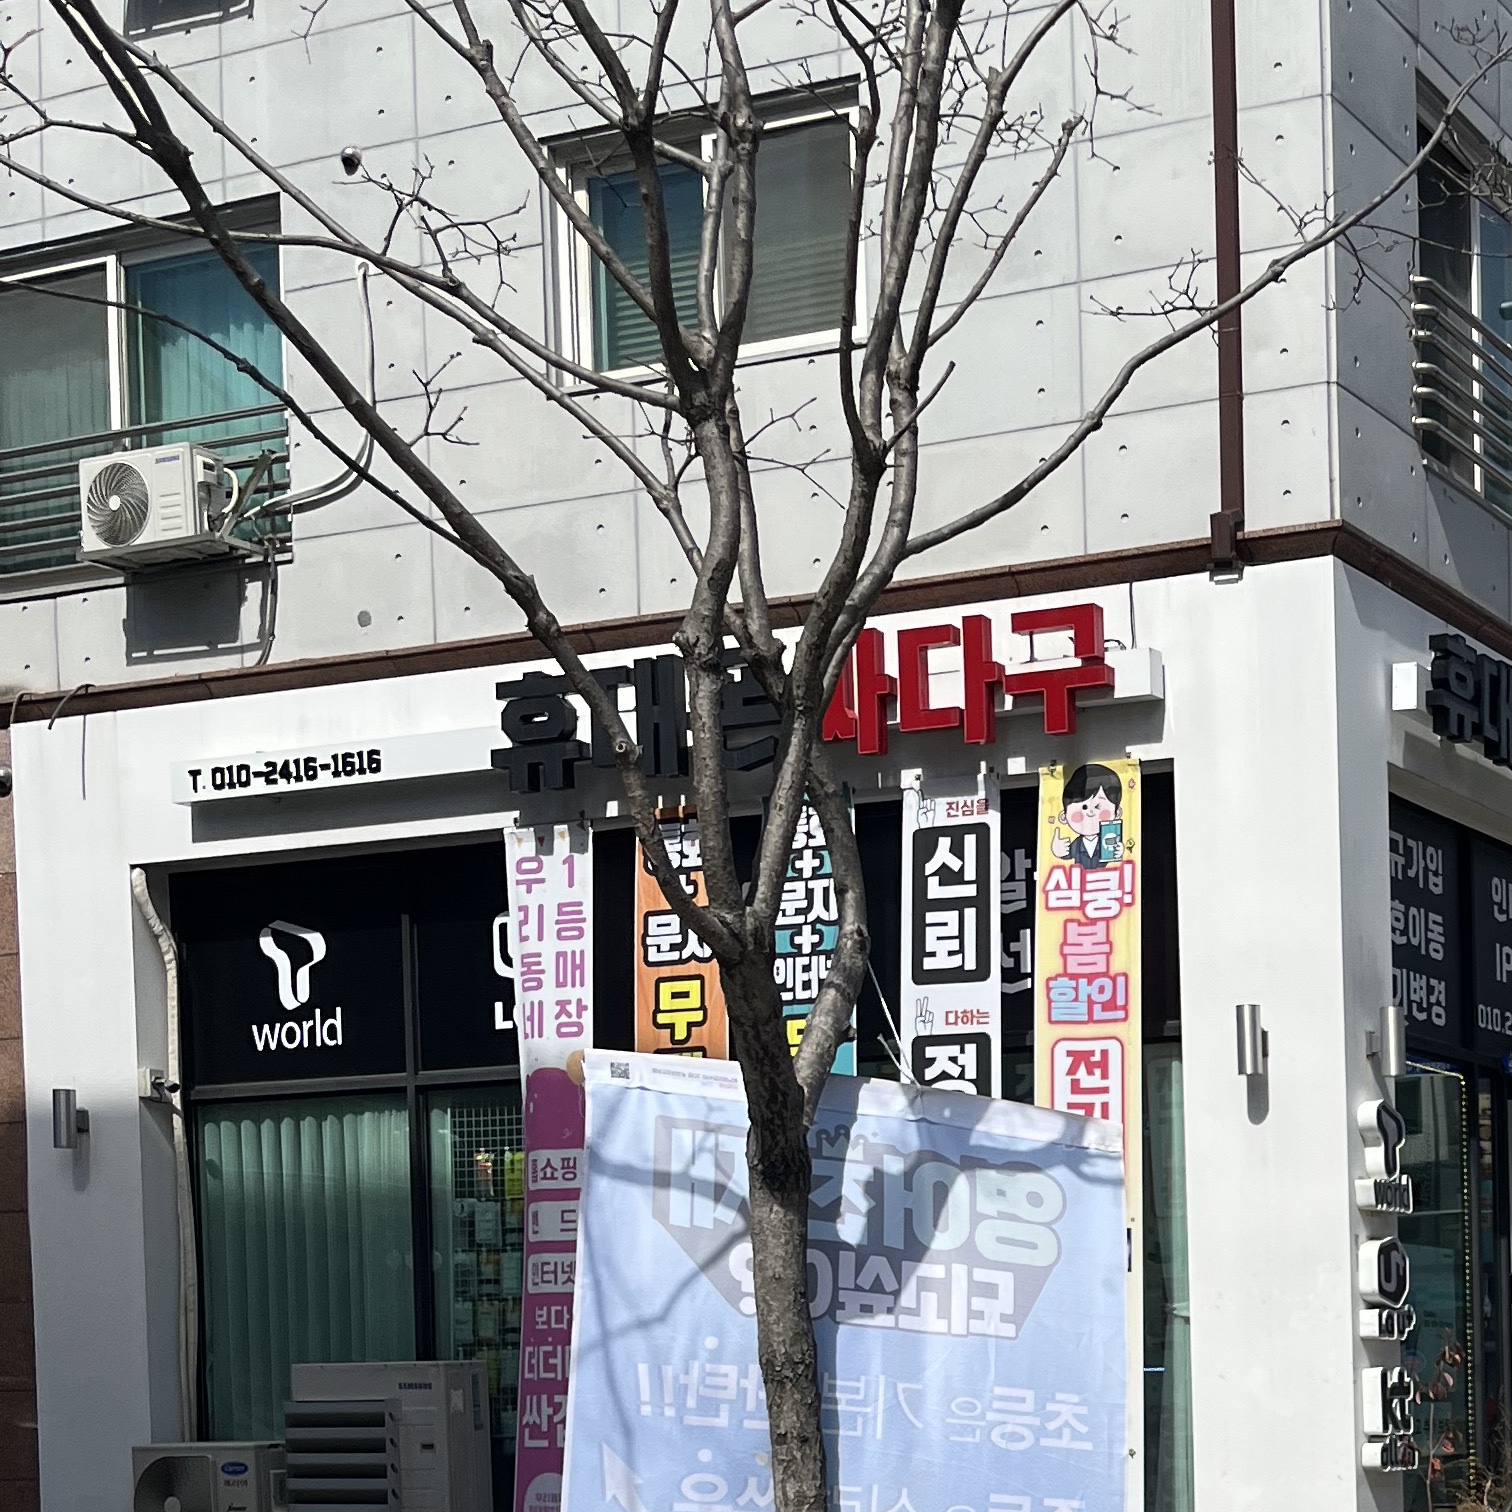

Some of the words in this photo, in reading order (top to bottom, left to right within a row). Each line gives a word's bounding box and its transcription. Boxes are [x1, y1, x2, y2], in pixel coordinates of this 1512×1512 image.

[210, 749, 383, 792] 010-2416-1616
[944, 799, 990, 818] 진심을
[923, 834, 980, 972] 신뢰
[1043, 864, 1135, 920] 심쿵!
[514, 855, 547, 1041] 우리동네
[1063, 920, 1128, 974] 봄
[944, 1009, 991, 1027] 다하는
[1045, 972, 1129, 1024] 할인
[252, 1007, 343, 1052] world
[532, 1156, 578, 1185] 쇼핑
[532, 1261, 577, 1288] 터넷
[534, 1305, 569, 1331] 보다
